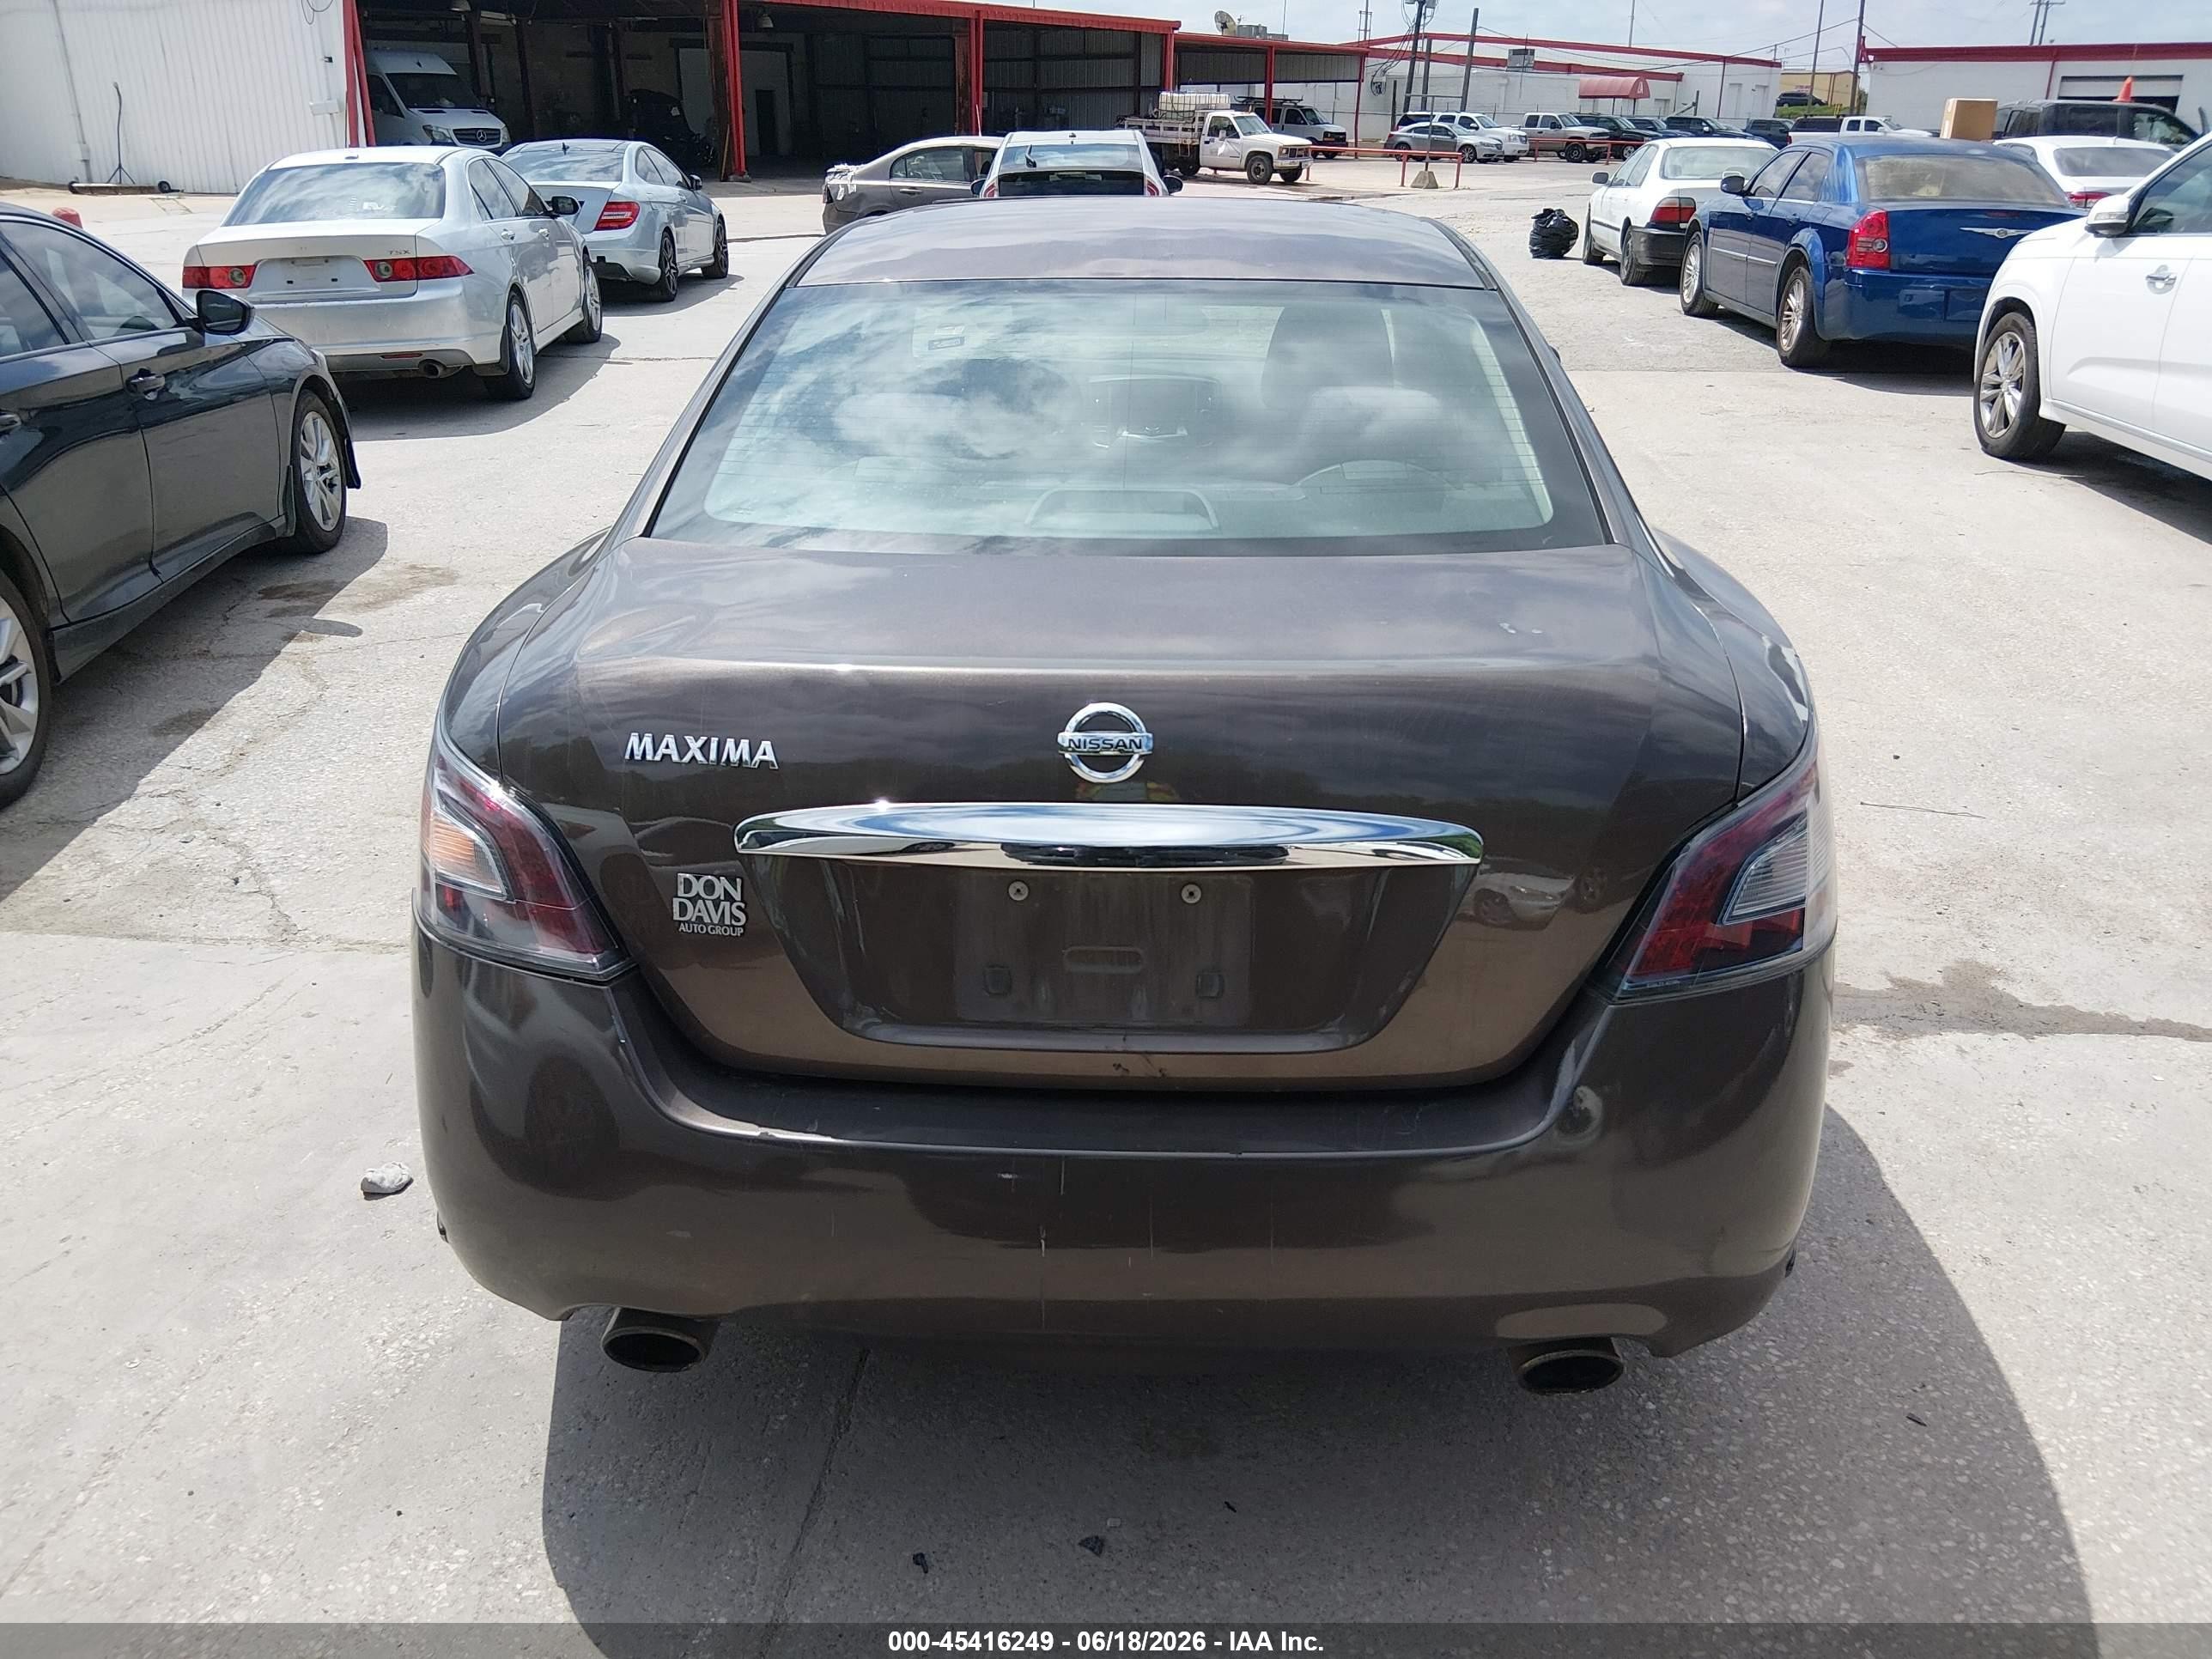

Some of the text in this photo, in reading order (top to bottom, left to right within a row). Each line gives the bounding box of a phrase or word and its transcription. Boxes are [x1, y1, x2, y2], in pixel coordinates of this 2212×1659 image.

[624, 732, 779, 769] MAXIMA
[1068, 738, 1142, 750] NISSAN
[677, 872, 742, 901] DON
[672, 897, 746, 927] DAVIS
[678, 923, 744, 937] AUTO GROUP
